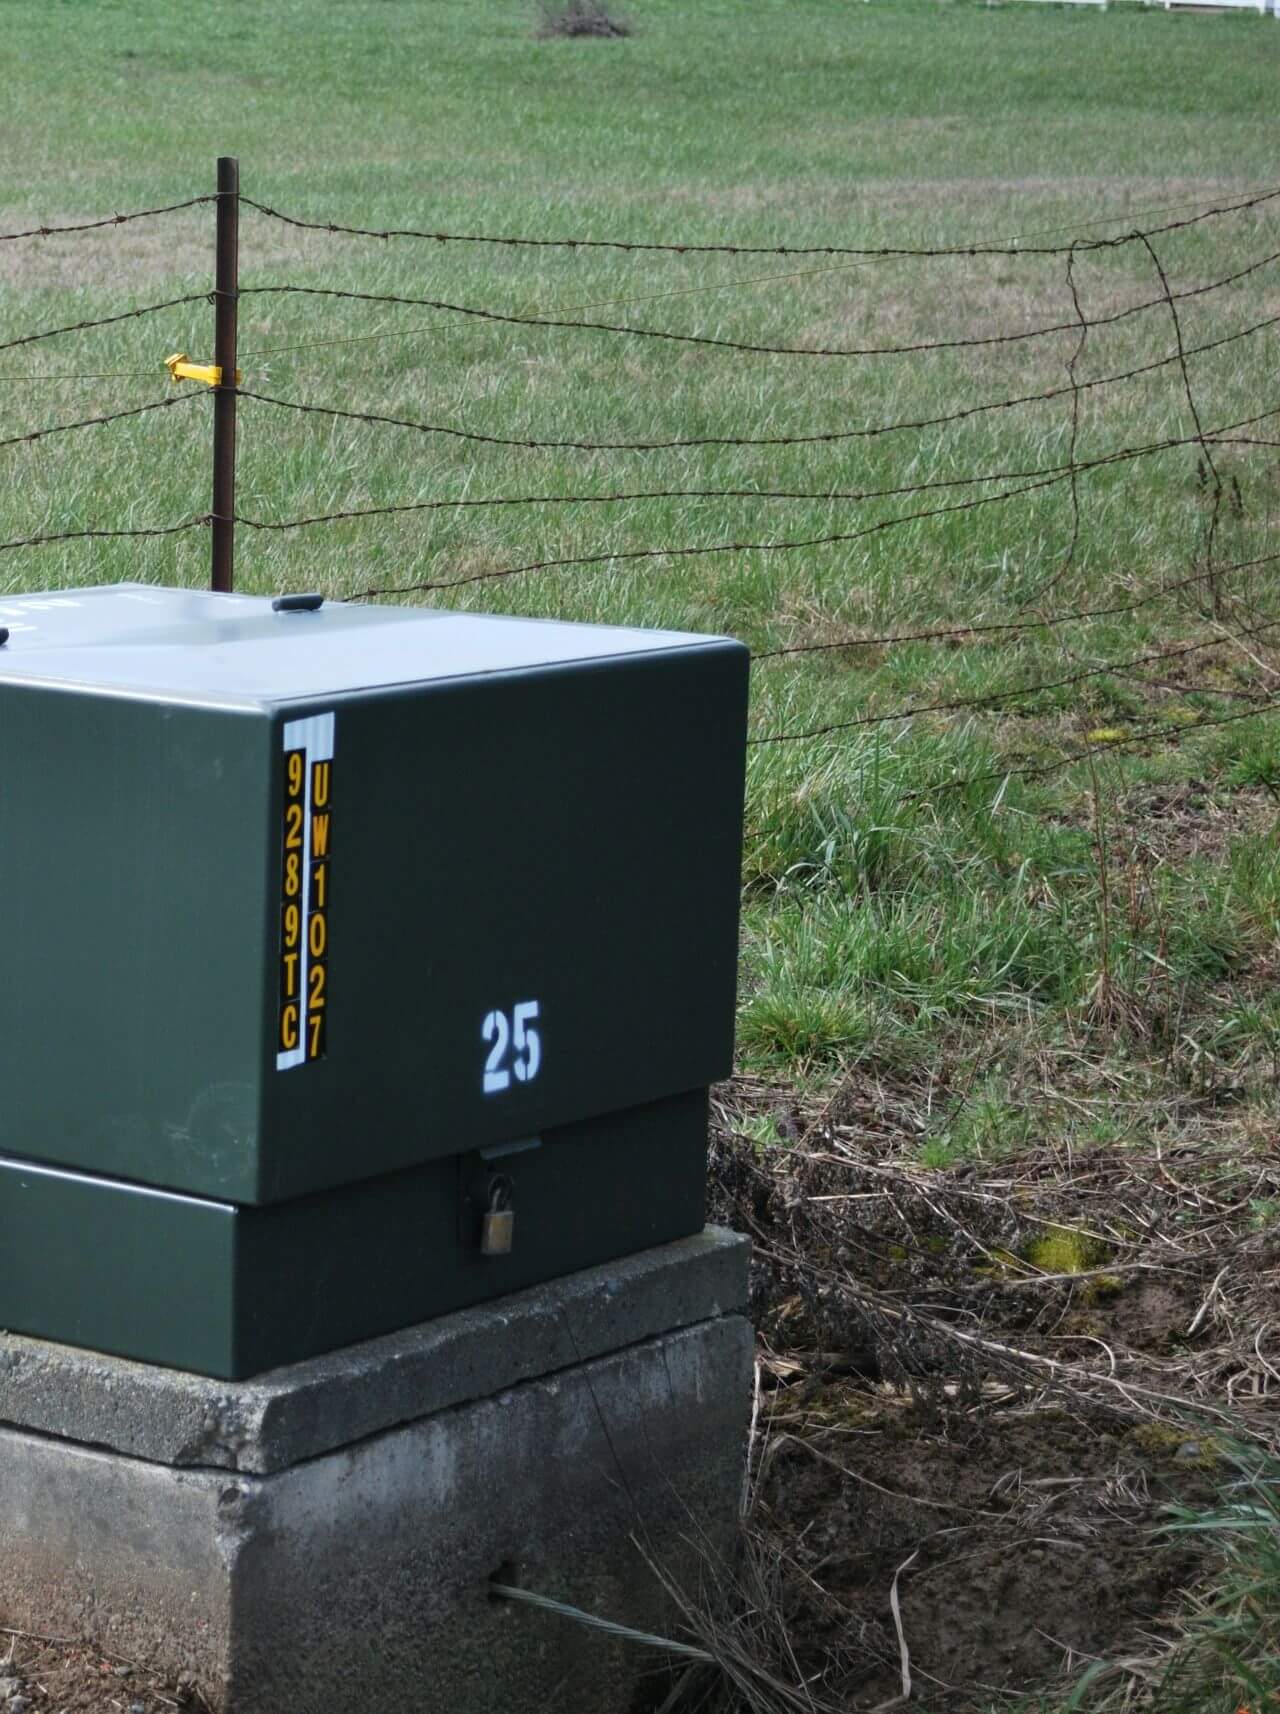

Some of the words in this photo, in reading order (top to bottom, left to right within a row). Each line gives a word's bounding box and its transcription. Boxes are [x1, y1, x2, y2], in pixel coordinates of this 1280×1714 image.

[282, 753, 303, 1050] 9289TC
[309, 762, 330, 1058] UW1027
[482, 1001, 541, 1093] 25
